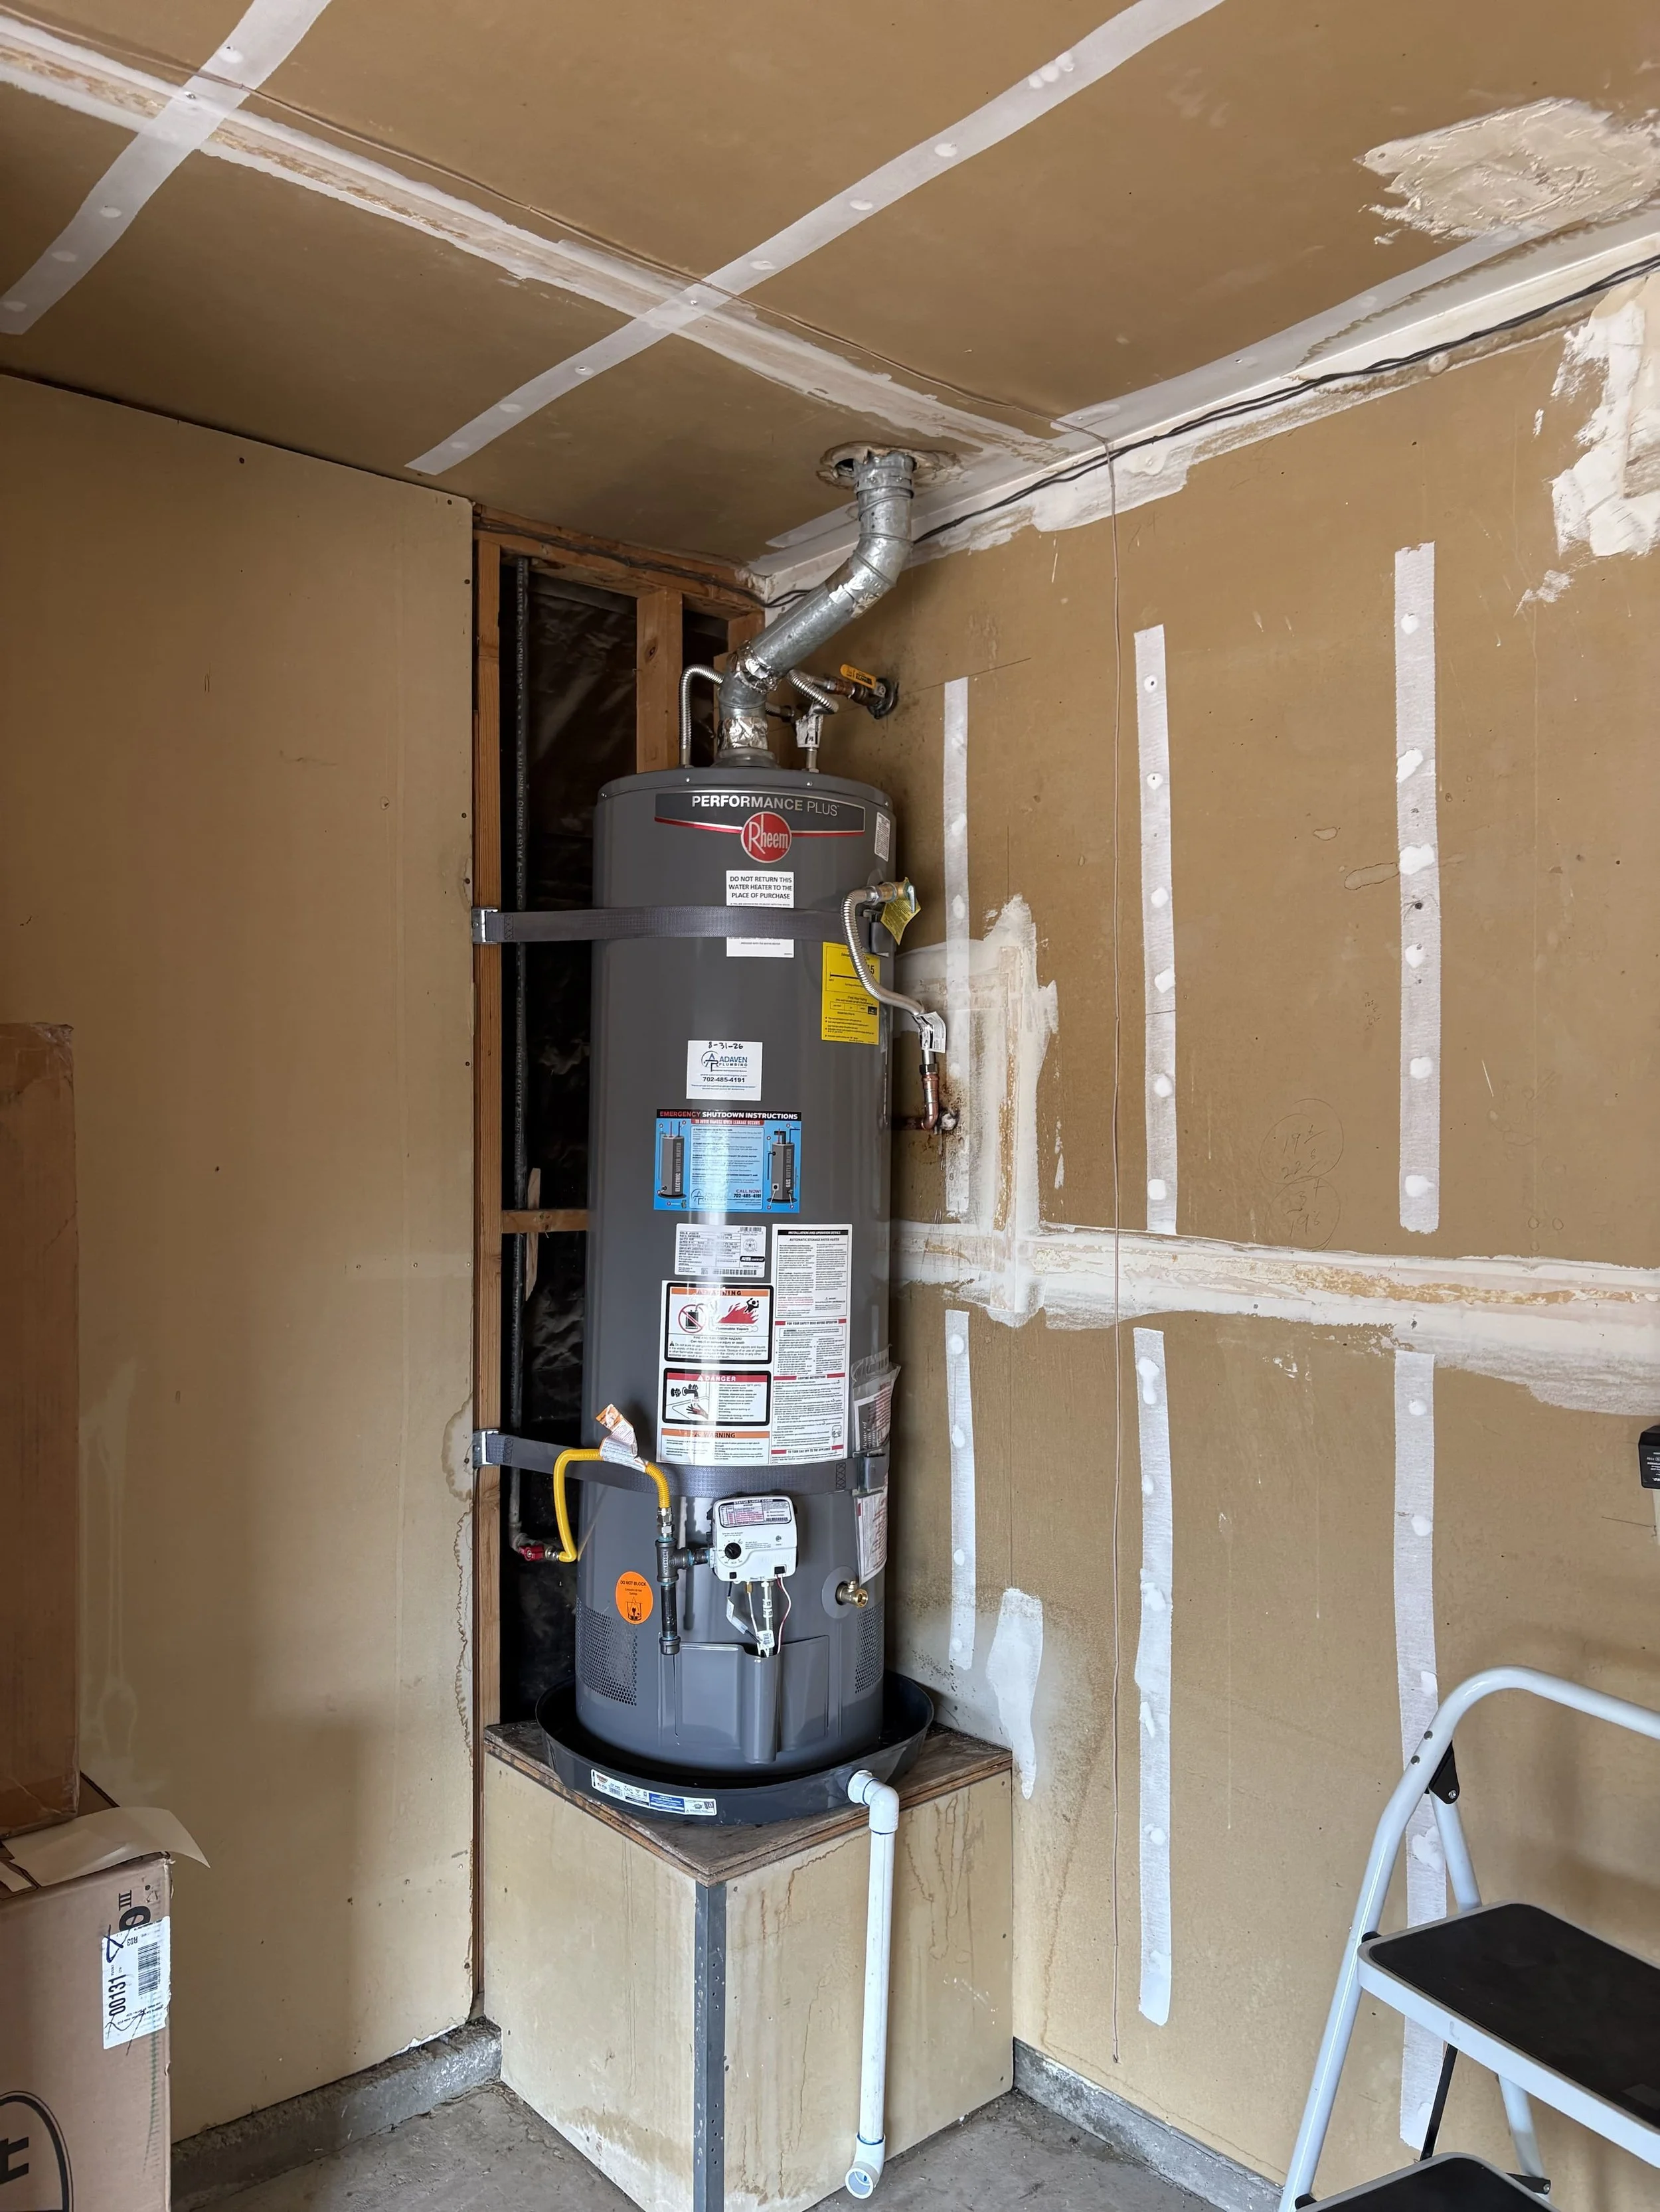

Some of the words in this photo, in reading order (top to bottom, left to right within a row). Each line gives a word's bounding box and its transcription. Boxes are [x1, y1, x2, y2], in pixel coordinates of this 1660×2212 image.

[691, 795, 803, 811] PERFORMANCE
[748, 814, 789, 854] Rheem
[108, 1974, 126, 2017] 00131
